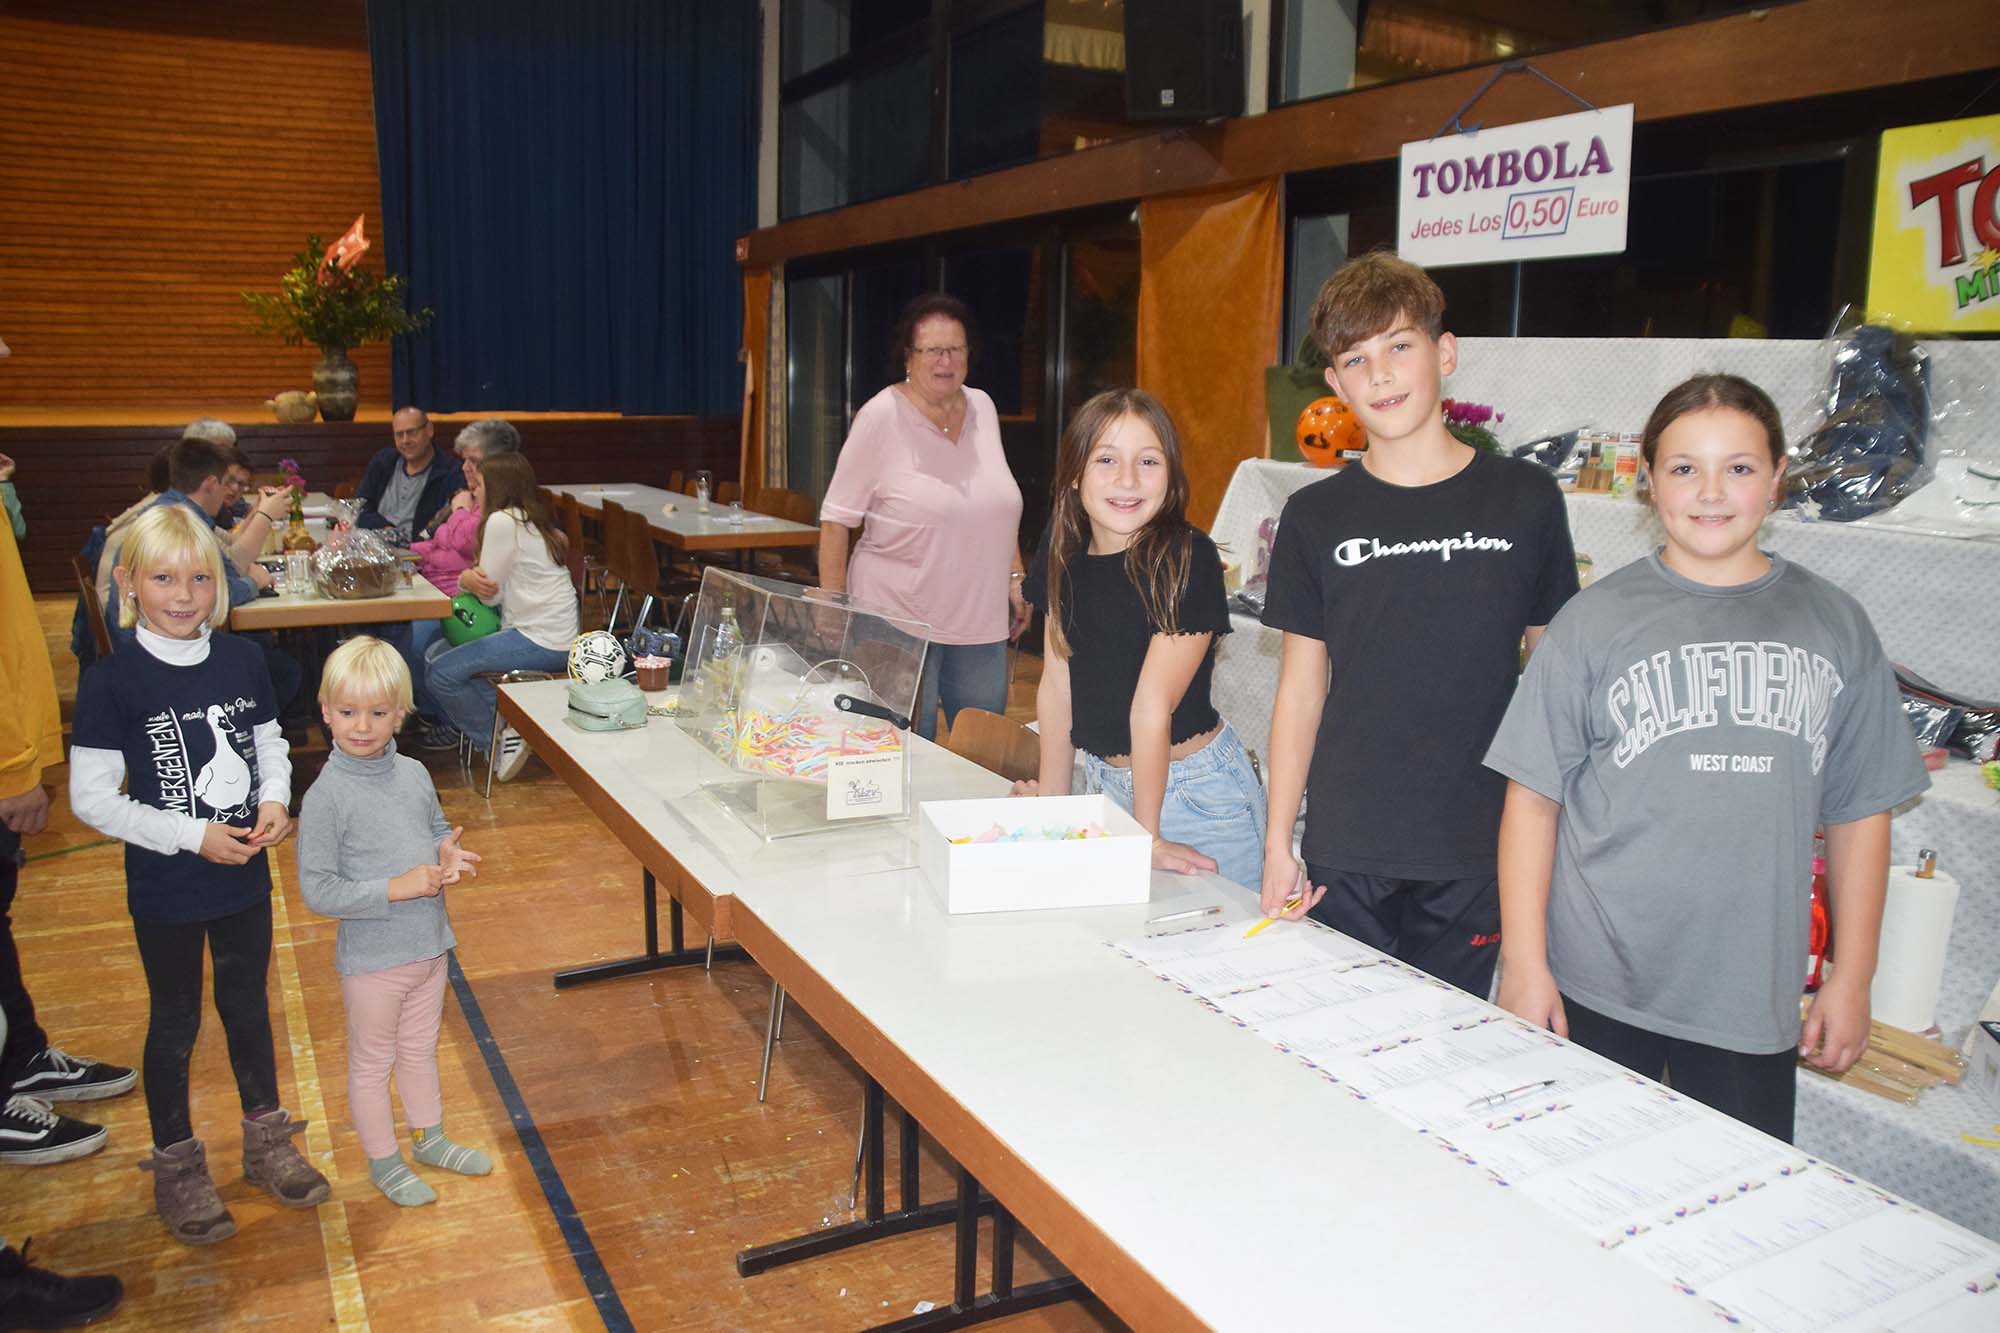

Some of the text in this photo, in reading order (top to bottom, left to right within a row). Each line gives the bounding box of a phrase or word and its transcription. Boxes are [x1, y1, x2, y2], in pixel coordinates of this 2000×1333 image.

[1413, 135, 1614, 198] TOMBOLA
[1411, 195, 1619, 240] Jedes Los 0,50 Euro
[1334, 531, 1513, 566] Champion
[145, 721, 190, 816] WERGENTEN
[1690, 754, 1774, 773] WEST COAST
